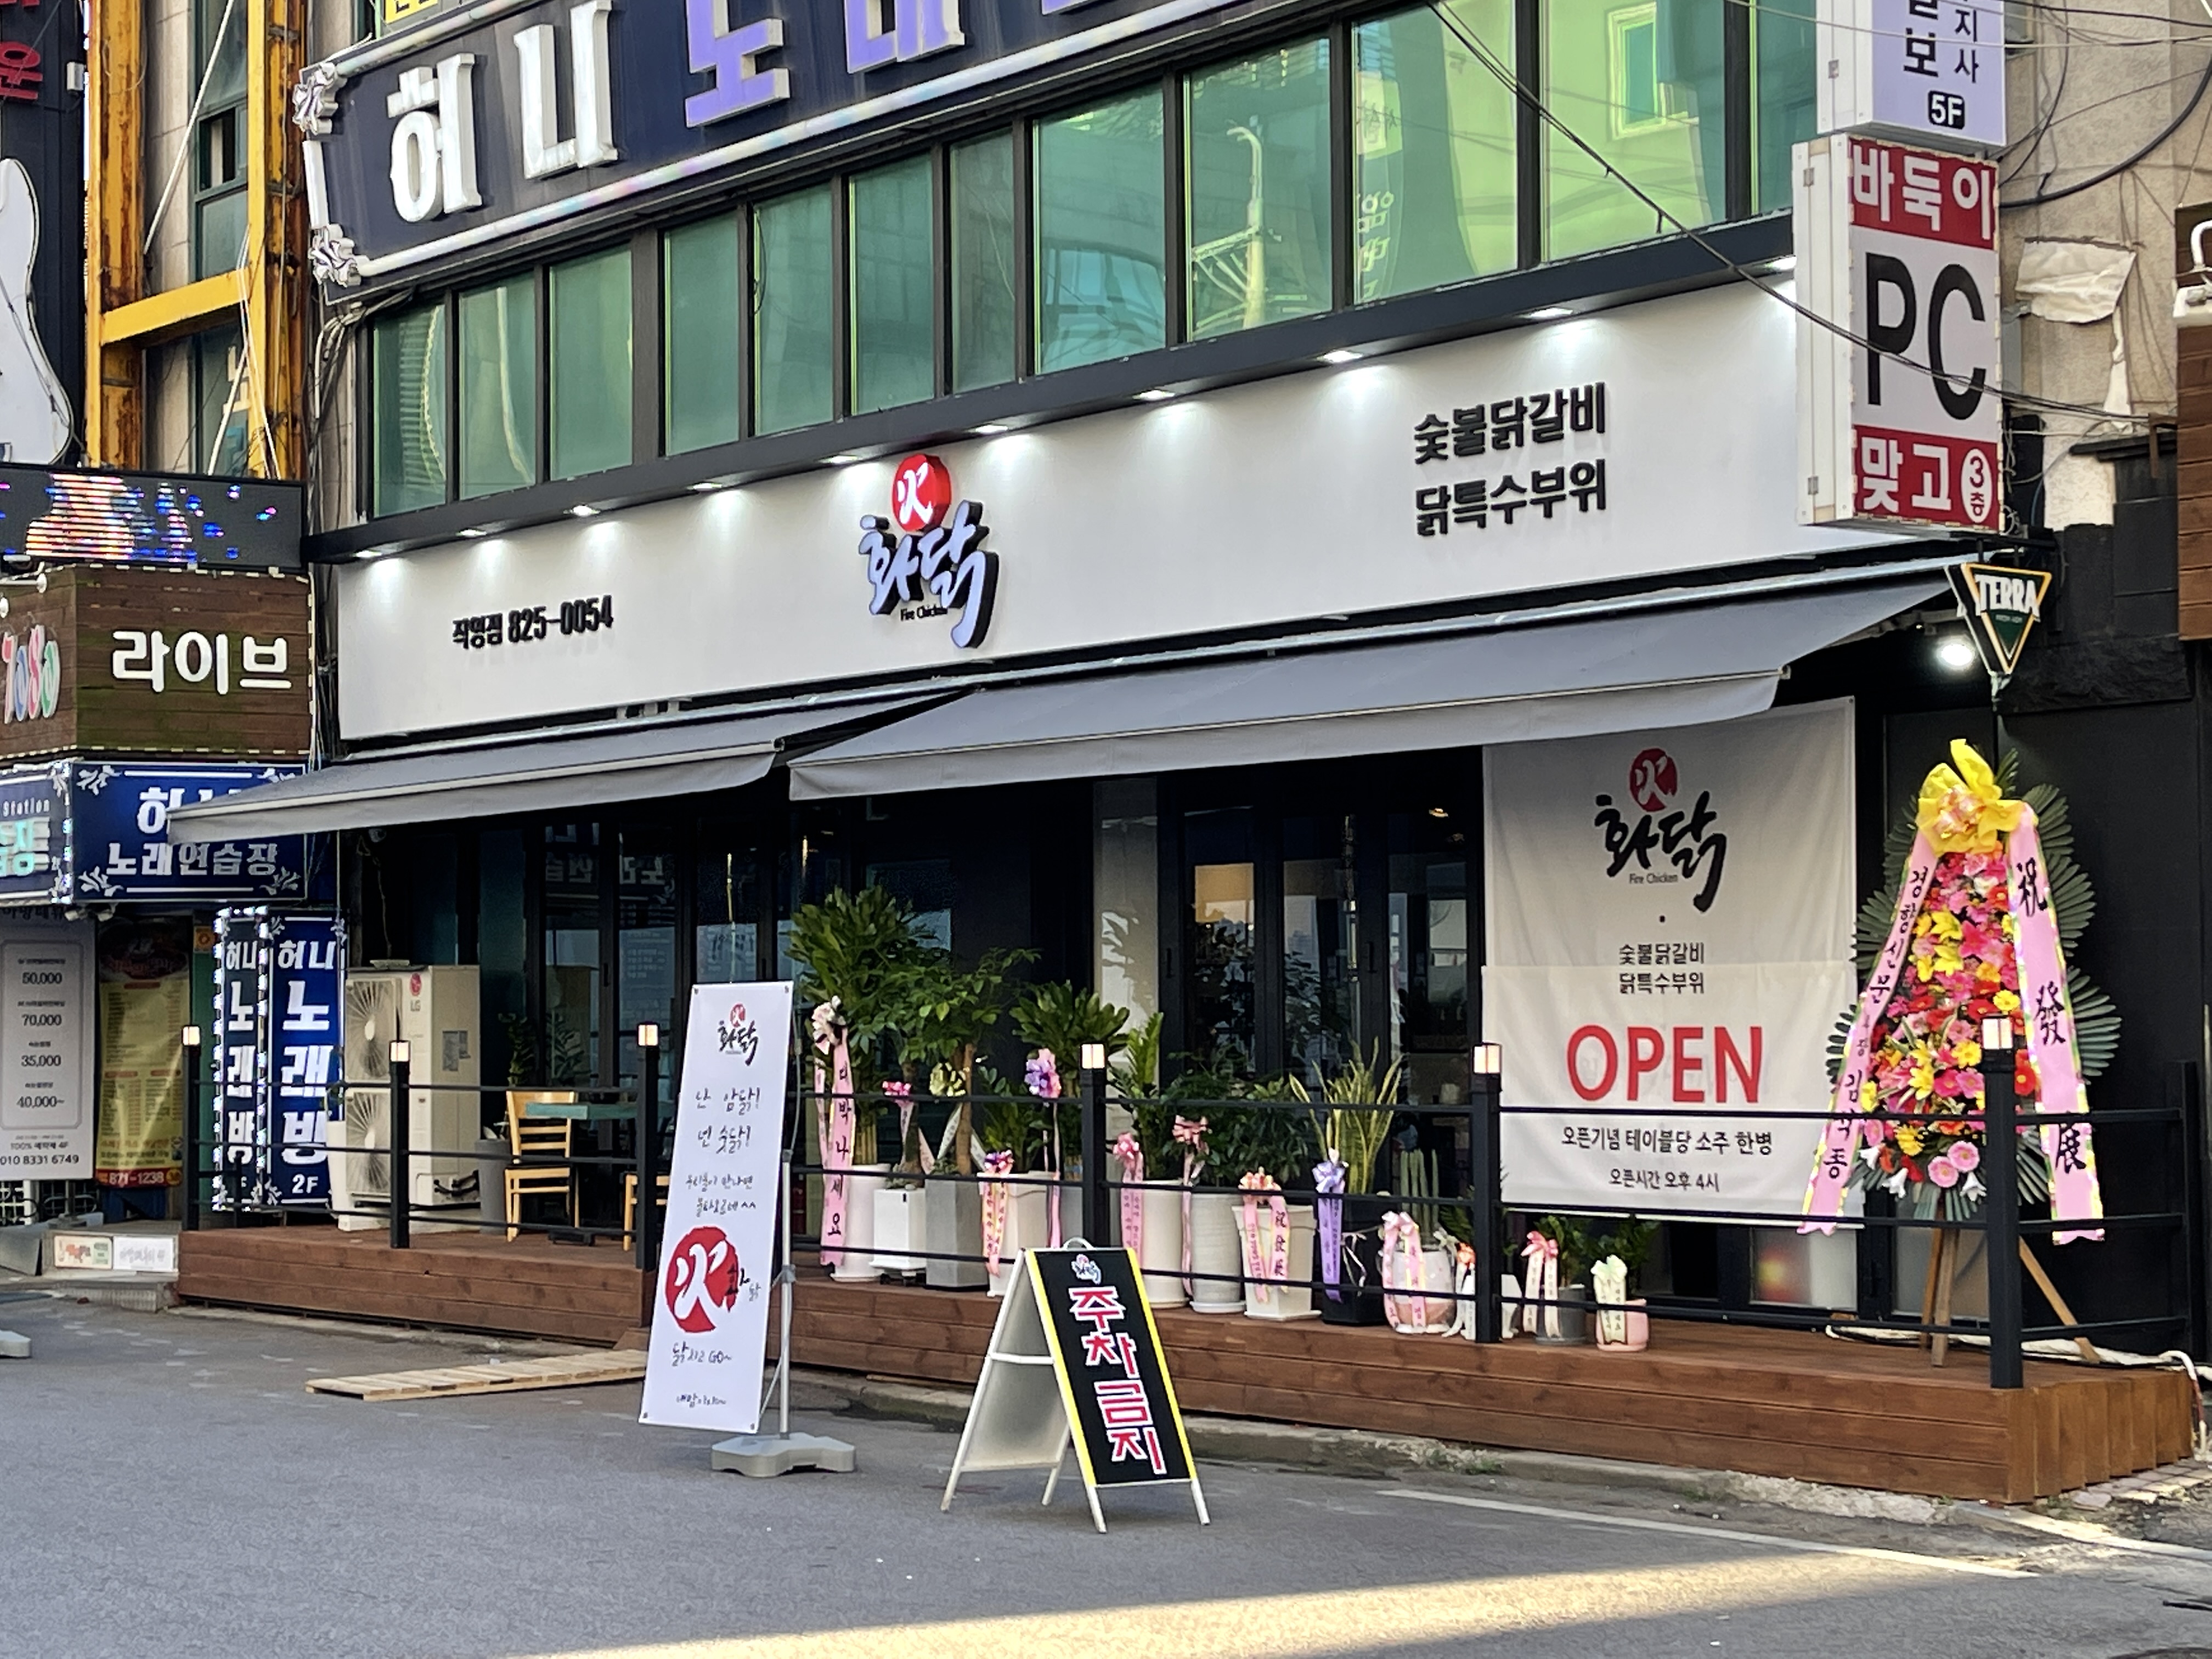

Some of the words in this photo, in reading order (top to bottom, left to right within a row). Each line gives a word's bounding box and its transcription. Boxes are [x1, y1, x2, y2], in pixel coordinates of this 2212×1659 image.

[387, 0, 618, 223] 허니
[1931, 93, 1963, 126] 5F
[1852, 146, 1991, 240] 바둑이
[1866, 252, 1986, 420] PC
[1414, 381, 1606, 465] 숯불닭갈비
[1861, 437, 1952, 512] 맞고
[1969, 456, 1985, 516] 3층
[1415, 459, 1607, 537] 닭특수부위
[859, 500, 998, 648] 화닭
[1974, 574, 2040, 618] TERRA
[507, 595, 614, 644] 825-0054
[112, 630, 292, 695] 라이브
[106, 842, 278, 876] 노래연습장
[1594, 791, 1728, 913] 화닭
[226, 940, 257, 969] 허니
[278, 939, 337, 969] 허니
[1618, 942, 1705, 966] 숯불닭갈비
[22, 972, 63, 985] 50,000
[1618, 972, 1705, 995] 닭특수부위
[21, 1013, 63, 1027] 70,000
[21, 1054, 62, 1068] 35,000
[1566, 1024, 1763, 1103] OPEN
[24, 1155, 48, 1165] 8331
[52, 1154, 80, 1164] 6749
[1561, 1125, 1621, 1151] 오픈기념
[1625, 1128, 1692, 1154] 테이블당
[1695, 1131, 1730, 1155] 소주
[1734, 1131, 1773, 1156] 한병
[292, 1173, 319, 1194] 2F
[1609, 1168, 1661, 1189] 오픈시간
[1664, 1171, 1692, 1191] 오후
[1696, 1172, 1720, 1192] 4시
[1068, 1285, 1167, 1476] 주차금지
